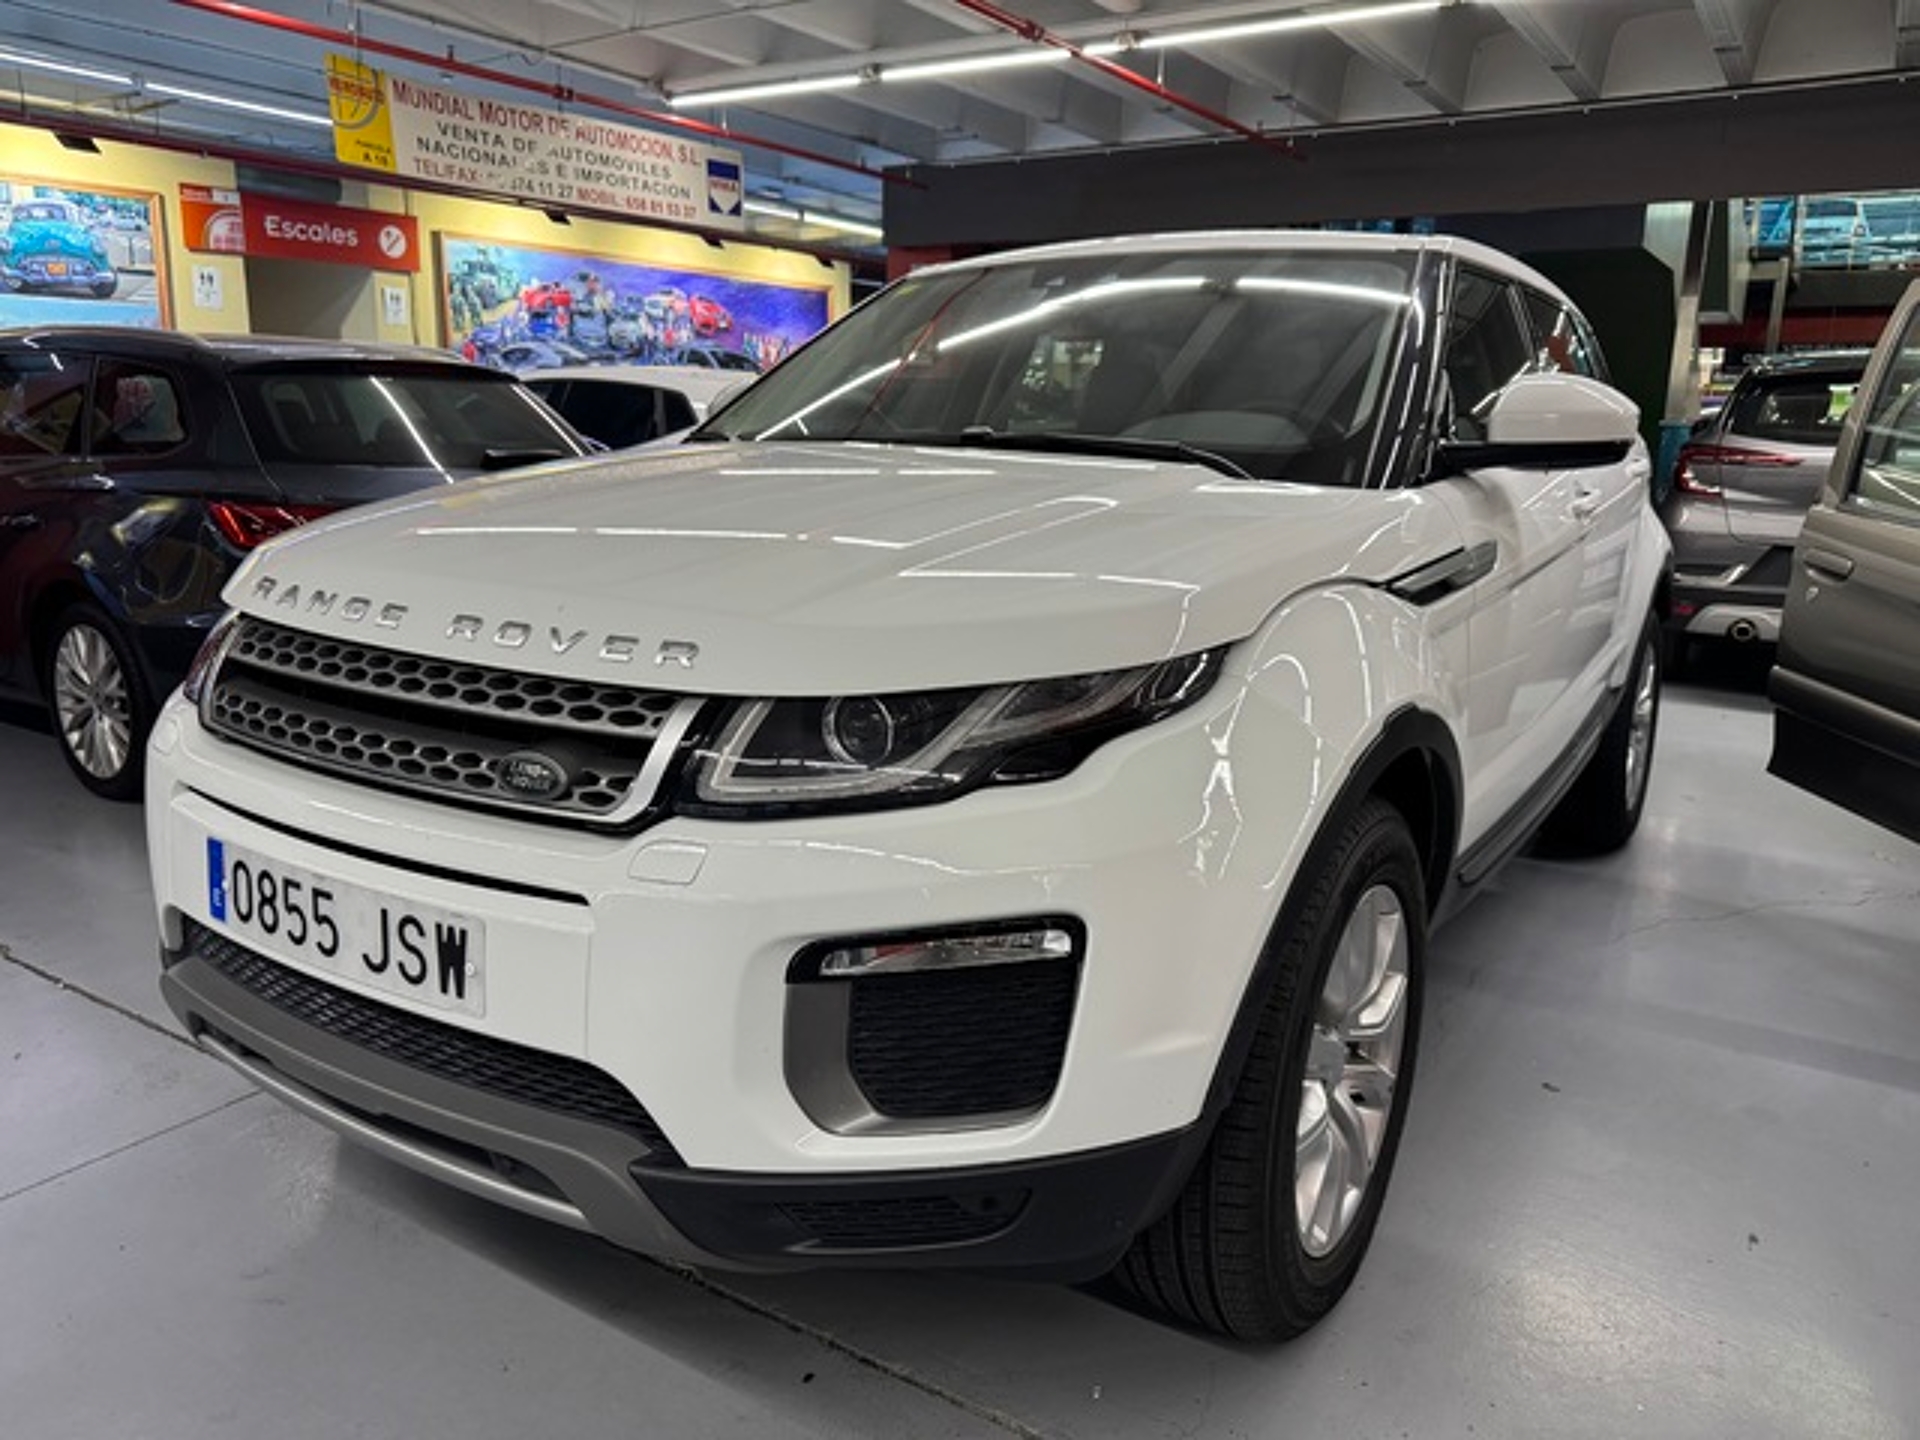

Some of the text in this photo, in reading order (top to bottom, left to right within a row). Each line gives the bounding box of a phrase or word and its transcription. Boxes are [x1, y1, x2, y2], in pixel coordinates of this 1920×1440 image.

[393, 79, 474, 120] MUNDIAL
[479, 101, 544, 133] MOTOR
[549, 116, 570, 138] DE
[416, 136, 549, 175] NACIONAS
[557, 163, 568, 178] E
[574, 166, 692, 200] IMPORTACION
[437, 120, 505, 148] VENTA
[546, 145, 672, 178] AUTOMOVILES
[264, 214, 359, 248] Escales
[253, 575, 700, 669] RANGE ROVER
[232, 859, 468, 1000] 0855 JSW
